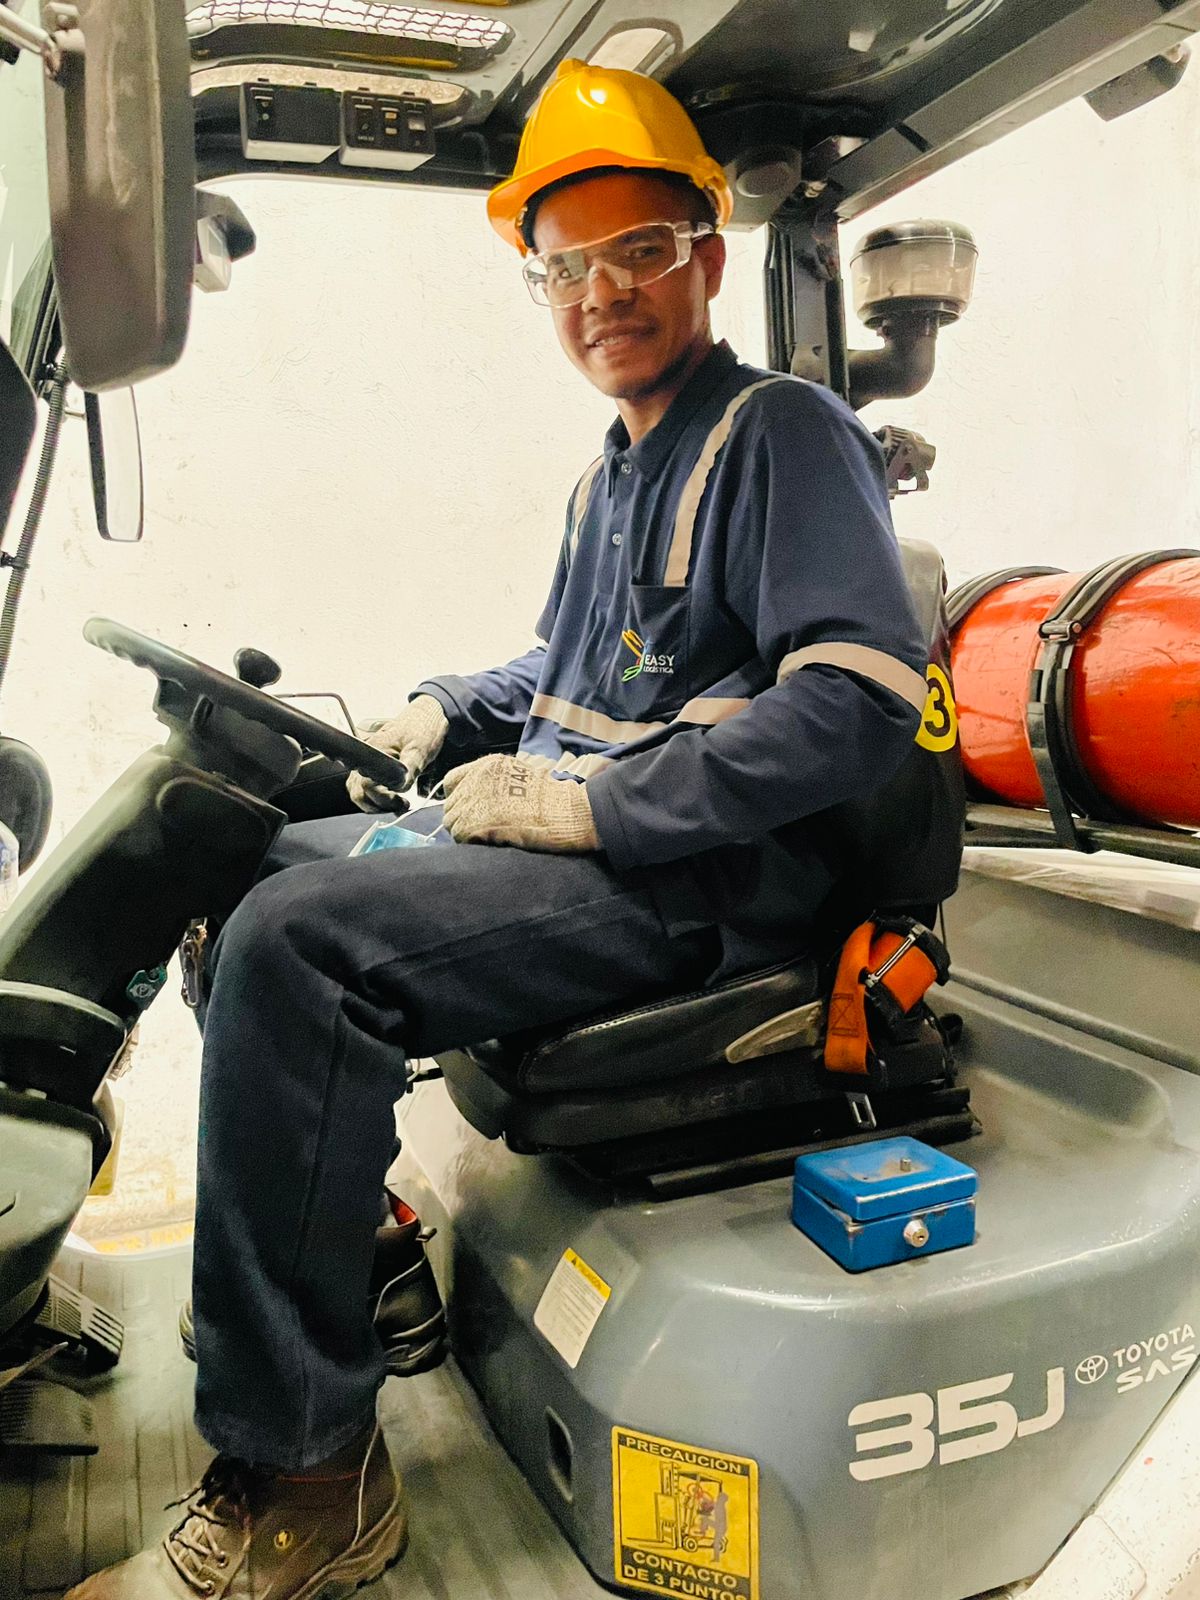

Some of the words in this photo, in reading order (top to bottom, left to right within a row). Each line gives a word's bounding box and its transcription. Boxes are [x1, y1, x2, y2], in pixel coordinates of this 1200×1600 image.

[644, 654, 675, 667] EASY
[926, 677, 951, 737] 3
[1112, 1323, 1196, 1368] TOYOTA
[1116, 1344, 1198, 1393] SAS
[848, 1367, 1065, 1481] 35J
[623, 1564, 649, 1582] DE
[654, 1573, 665, 1586] 3
[632, 1551, 737, 1589] CONTACTO
